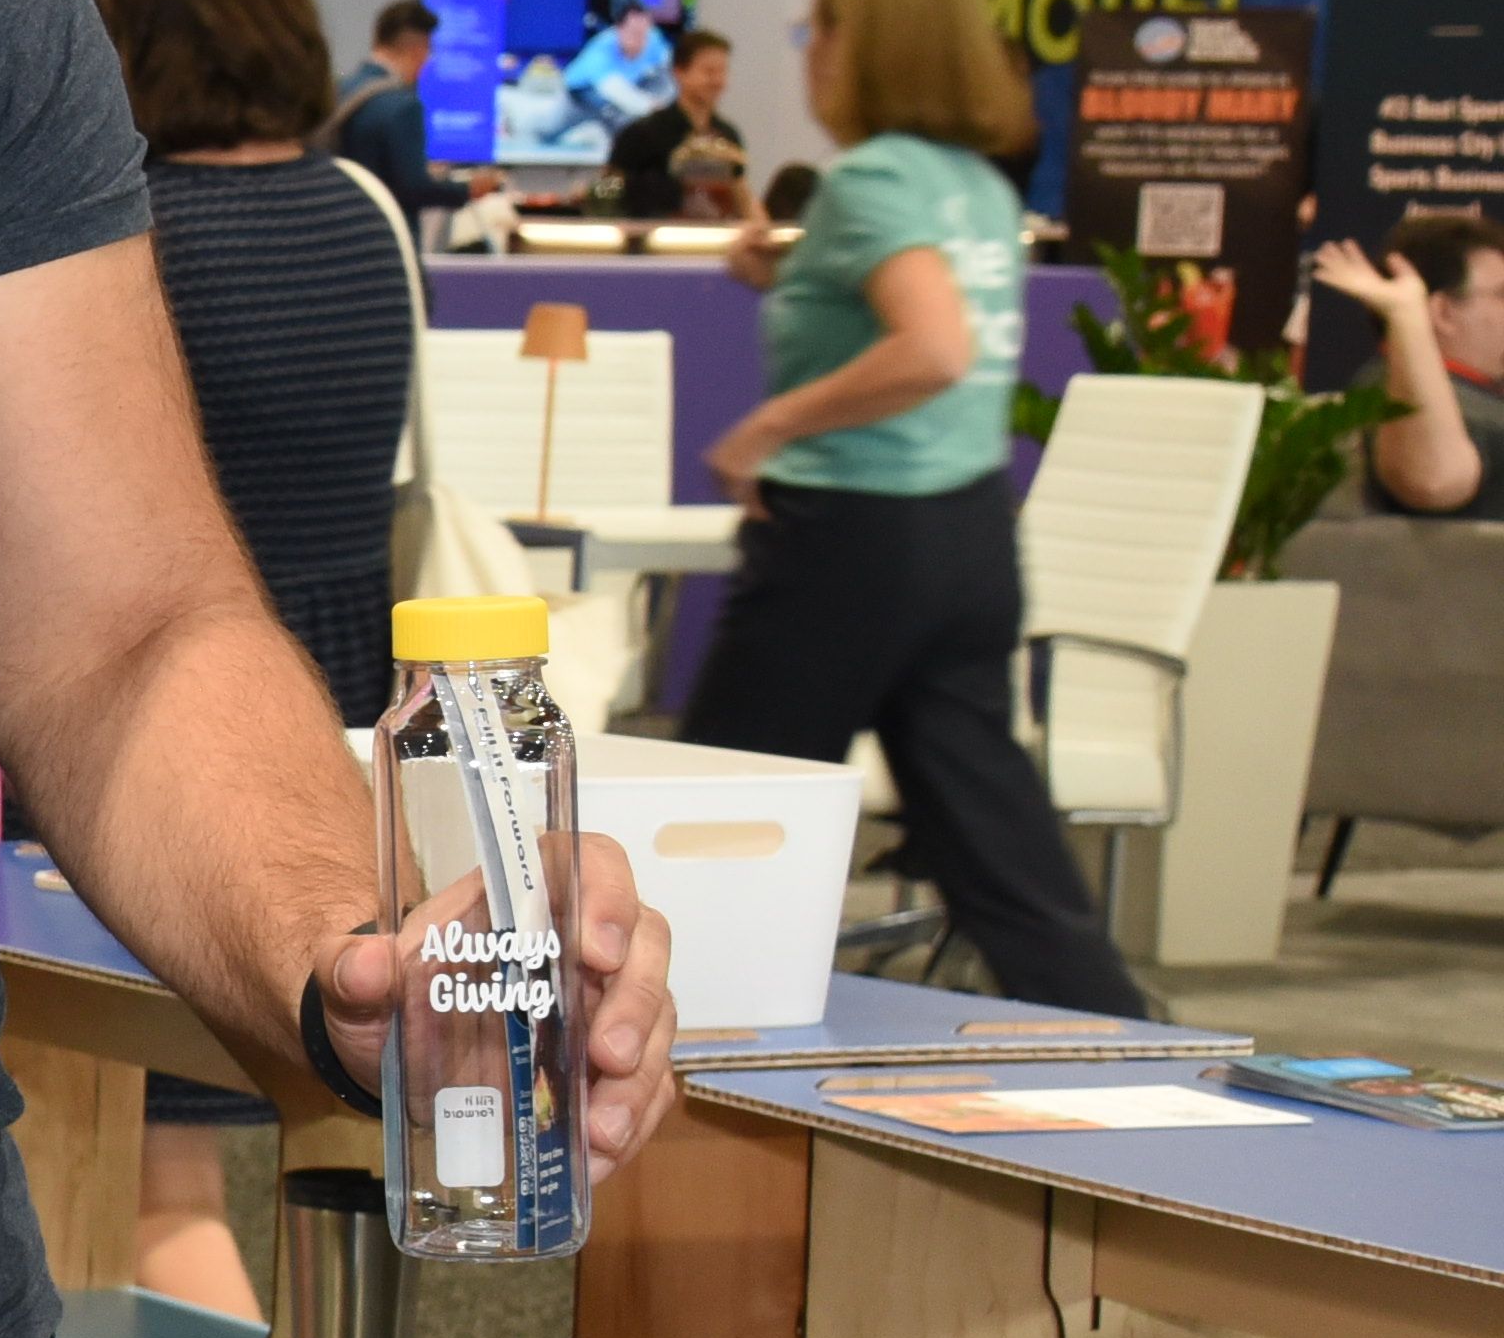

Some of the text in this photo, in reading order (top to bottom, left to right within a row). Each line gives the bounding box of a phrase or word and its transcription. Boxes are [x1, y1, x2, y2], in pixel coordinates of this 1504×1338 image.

[500, 776, 535, 891] Forward
[419, 919, 561, 970] Always
[428, 971, 556, 1020] Giving
